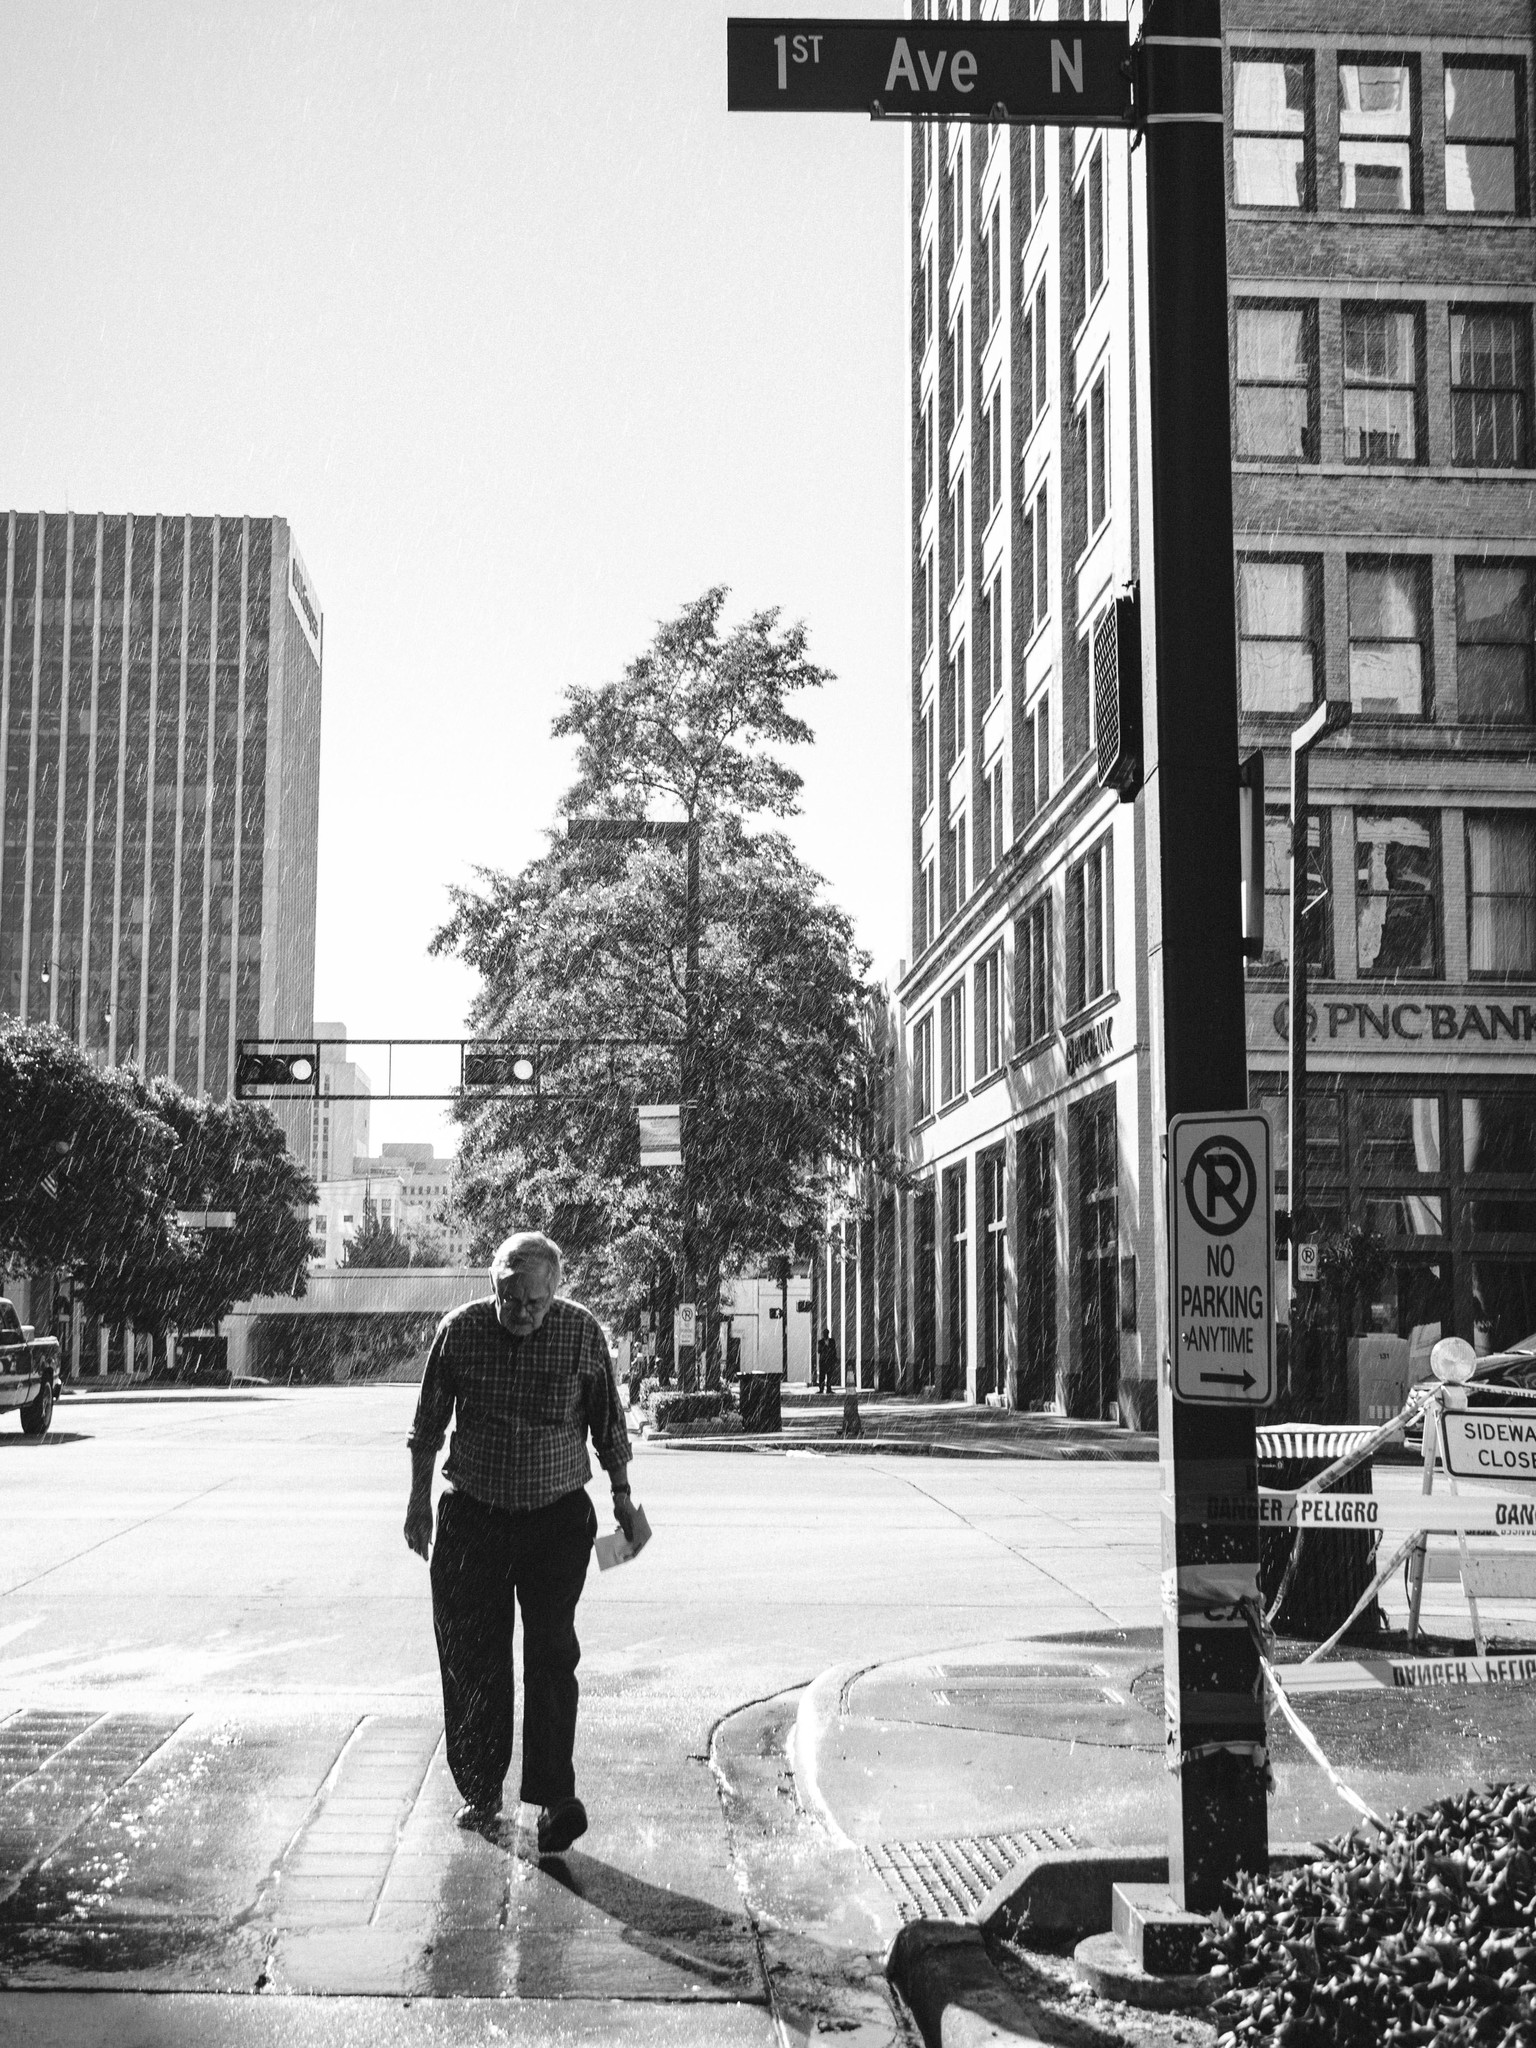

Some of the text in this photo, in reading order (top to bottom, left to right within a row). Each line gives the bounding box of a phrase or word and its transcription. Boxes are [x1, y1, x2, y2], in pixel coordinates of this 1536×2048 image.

[774, 35, 1083, 93] 1ST Ave N
[1207, 1244, 1234, 1278] NO
[1181, 1285, 1263, 1319] PARKING
[1187, 1326, 1254, 1354] ANYTIME
[1301, 1500, 1379, 1523] PELIGRO
